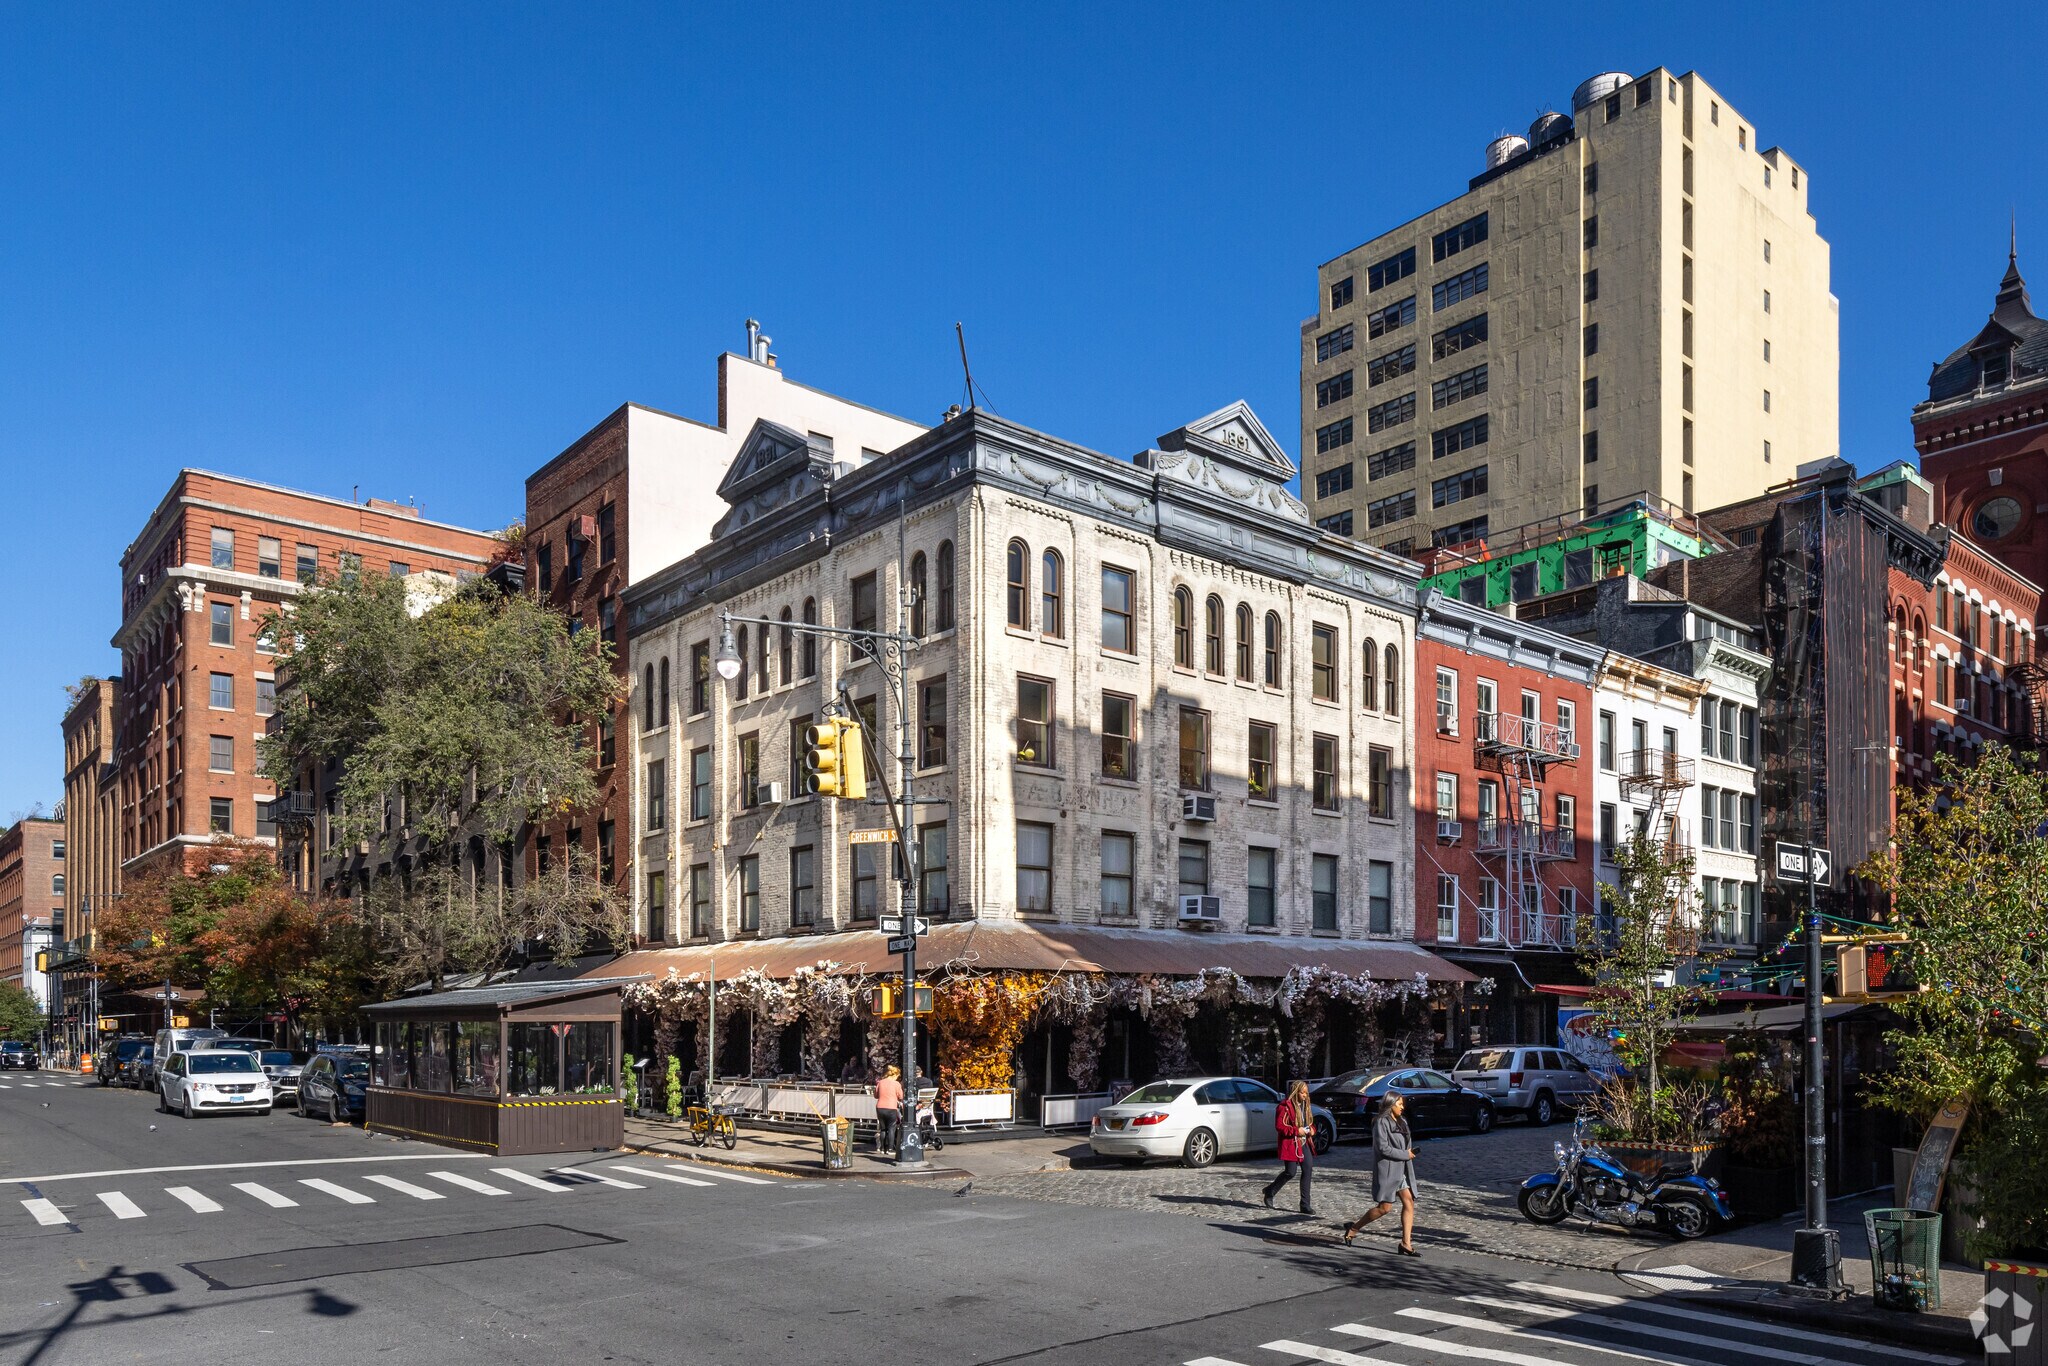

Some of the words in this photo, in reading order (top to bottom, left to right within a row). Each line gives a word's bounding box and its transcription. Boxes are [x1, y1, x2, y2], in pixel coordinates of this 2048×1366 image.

[1222, 429, 1251, 453] 1891
[851, 831, 888, 843] GREENWICH
[1785, 855, 1800, 870] ONE
[891, 942, 900, 950] ONE
